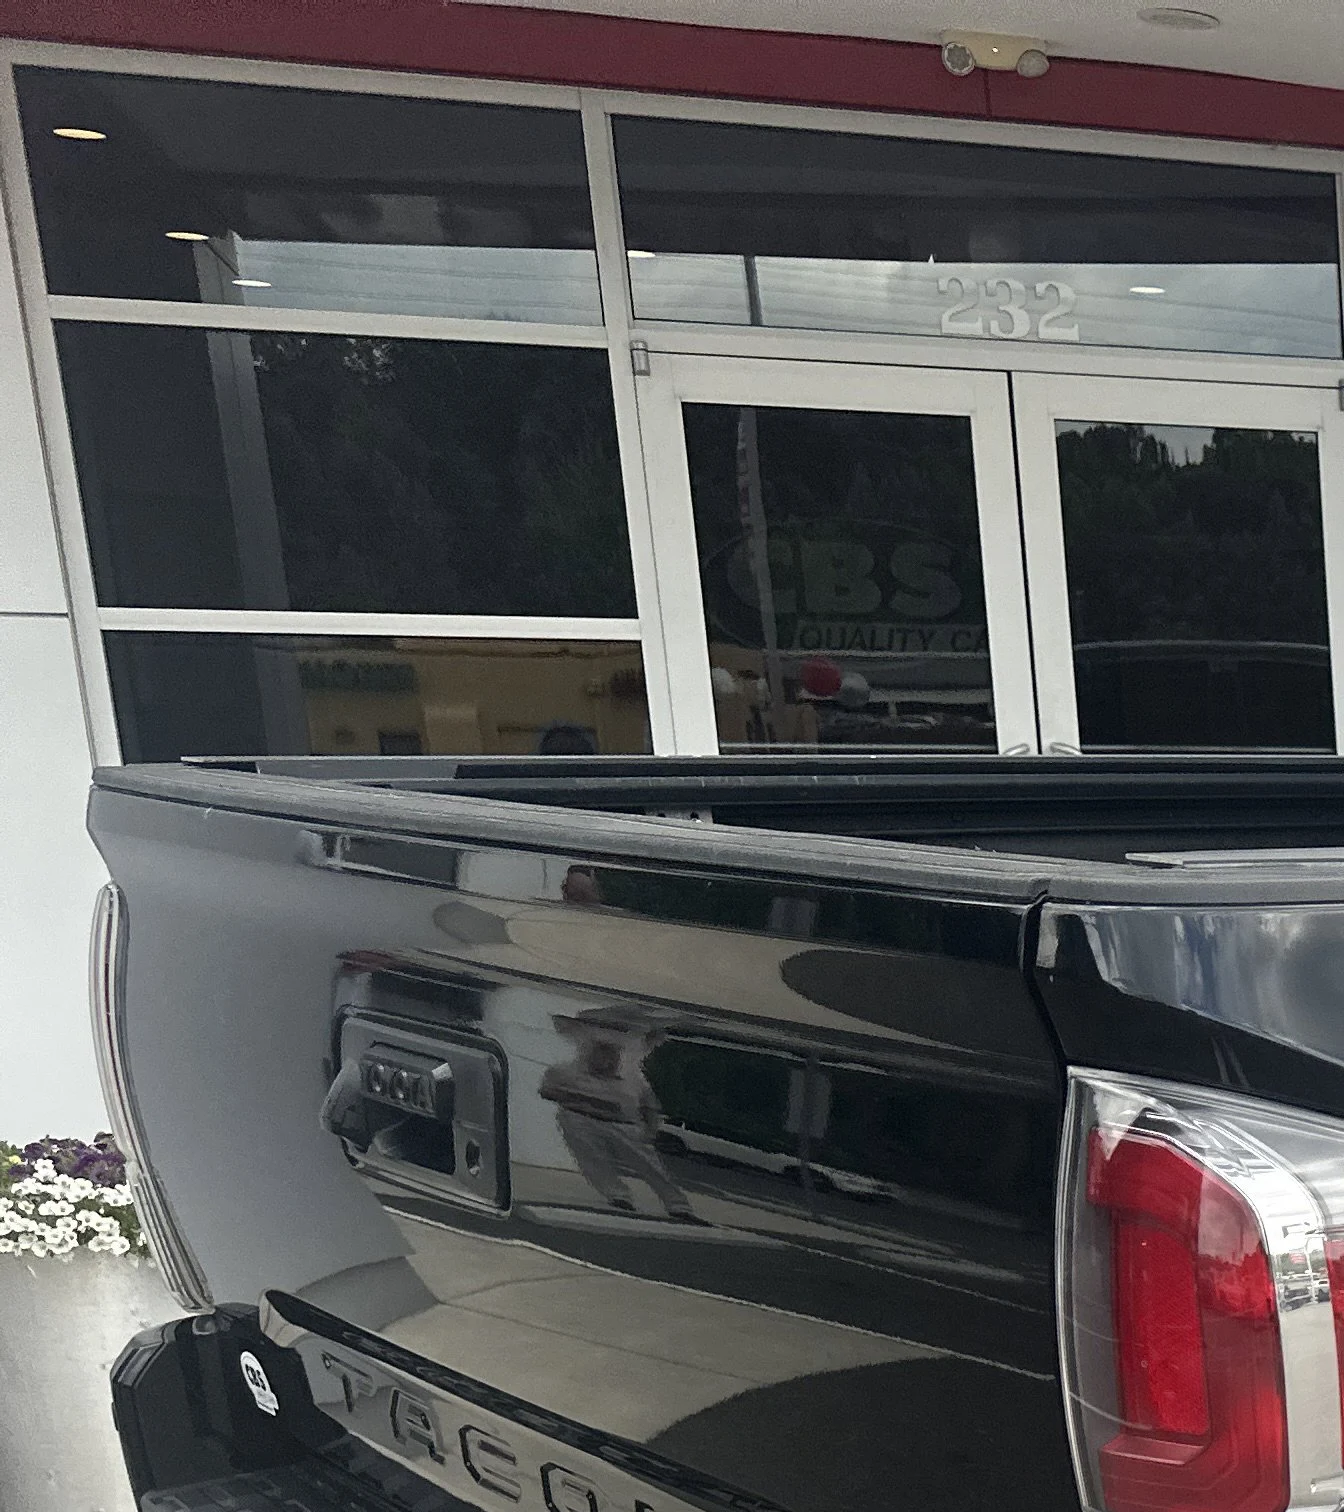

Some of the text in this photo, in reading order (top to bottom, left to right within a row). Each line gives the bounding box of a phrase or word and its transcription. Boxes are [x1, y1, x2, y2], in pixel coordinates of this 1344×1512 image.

[937, 277, 1080, 342] 232
[728, 538, 962, 618] CBS
[799, 625, 934, 652] QUALITY
